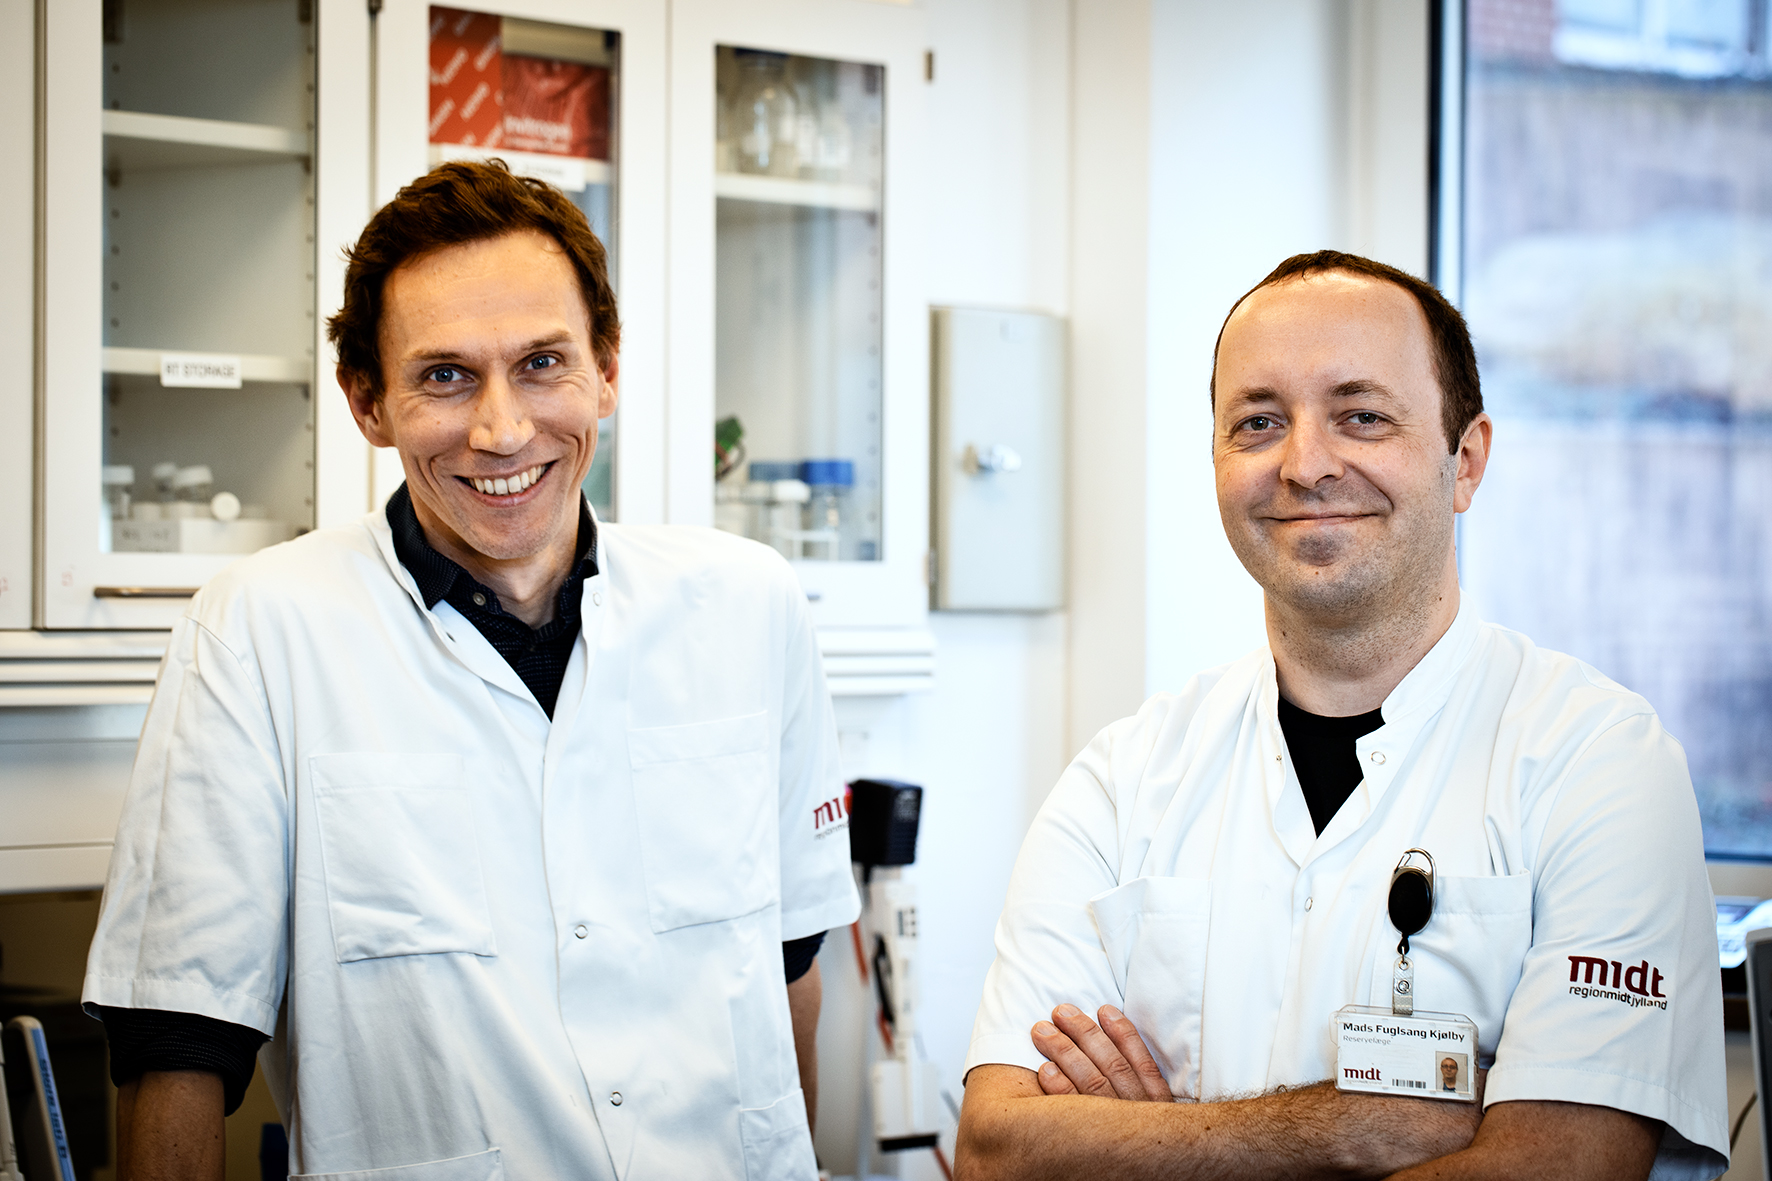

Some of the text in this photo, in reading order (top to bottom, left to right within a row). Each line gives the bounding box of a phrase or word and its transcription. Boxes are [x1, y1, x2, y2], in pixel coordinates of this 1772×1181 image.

[183, 362, 235, 380] STORAGE
[1567, 955, 1667, 998] midt
[1568, 986, 1668, 1010] regionmidtjylland
[1343, 1022, 1465, 1043] Mads Fuglsang Kjølby
[1343, 1035, 1391, 1046] Reservelæge
[1342, 1067, 1382, 1081] midt
